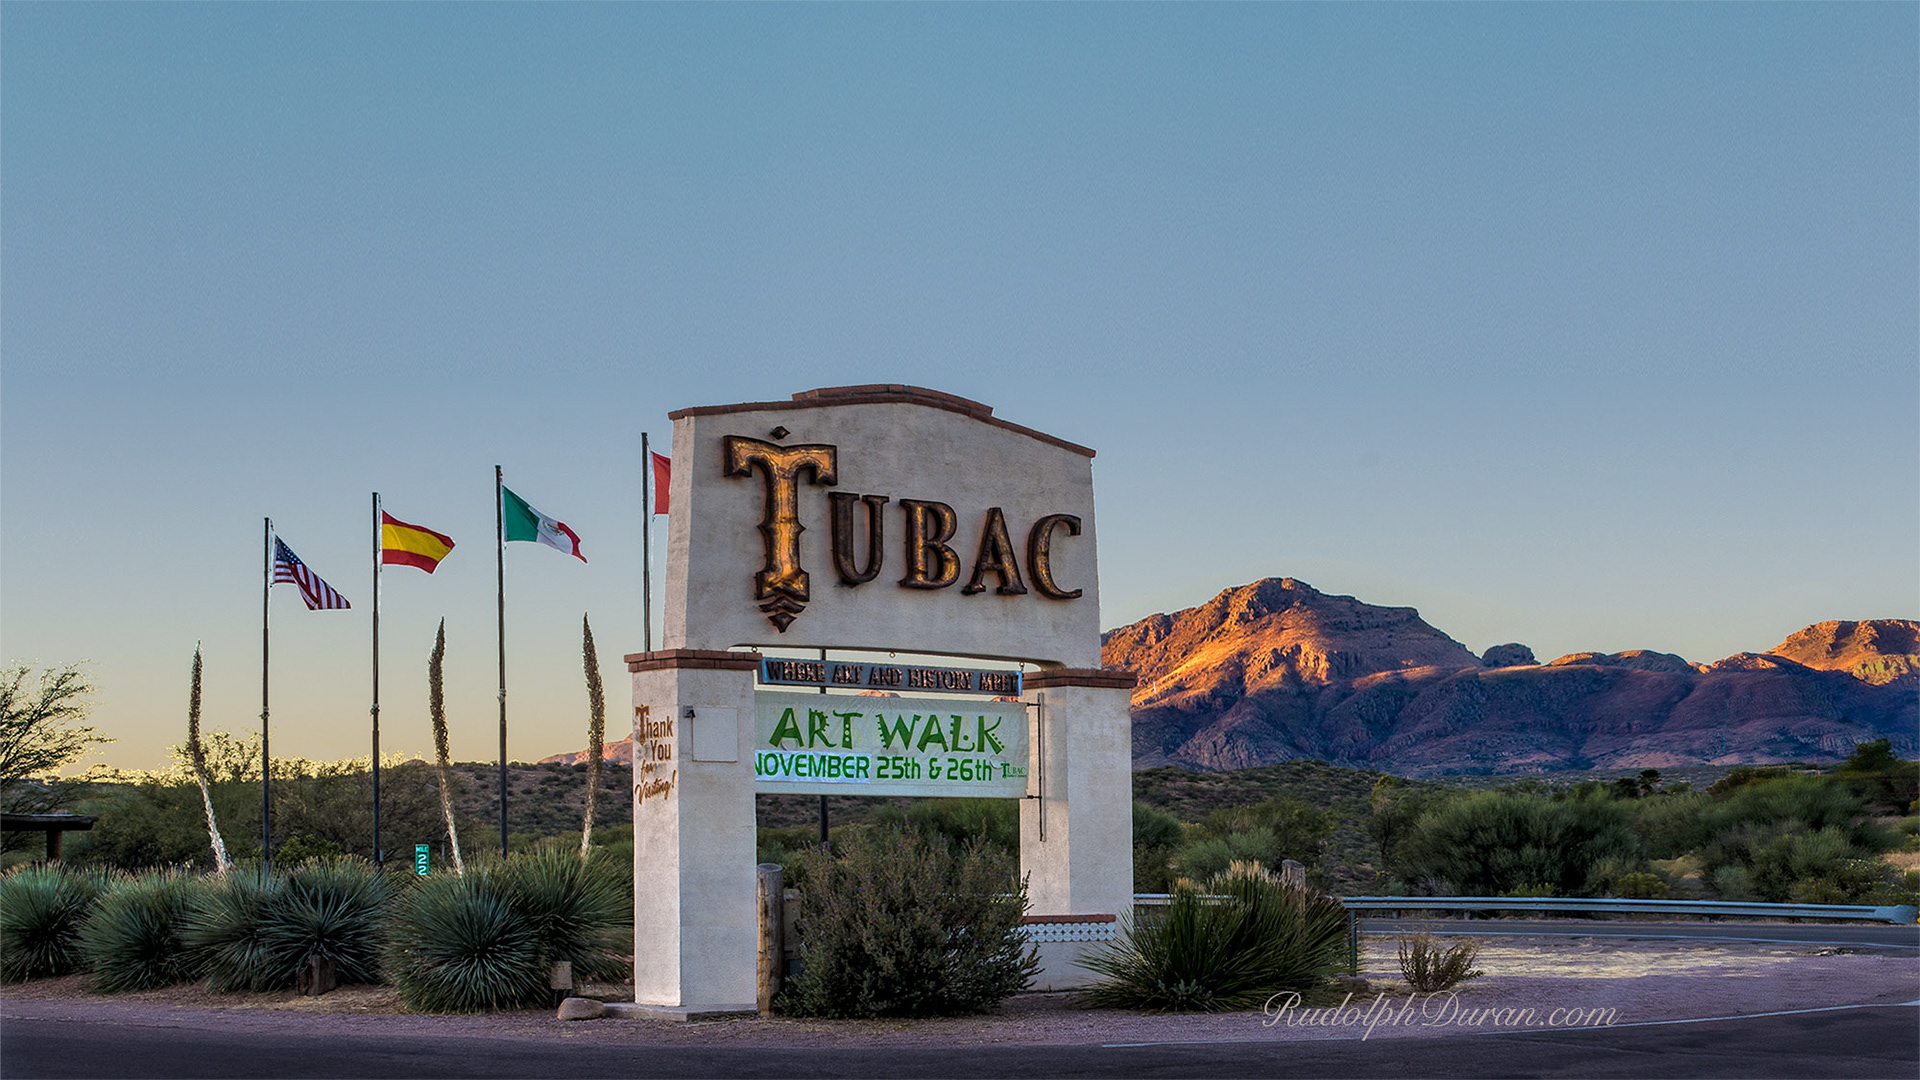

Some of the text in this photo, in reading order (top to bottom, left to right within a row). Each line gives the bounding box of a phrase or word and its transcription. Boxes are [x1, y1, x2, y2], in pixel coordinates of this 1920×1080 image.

[723, 432, 1083, 632] TUBAC
[766, 660, 1019, 693] WHERE ART AND HISTORY MEET
[635, 704, 673, 746] Thank
[769, 707, 1005, 754] ART WALK
[650, 740, 671, 761] You
[641, 760, 655, 783] for
[876, 755, 921, 780] 25th
[928, 757, 942, 780] &
[946, 757, 992, 782] 26th
[635, 770, 676, 805] Visiting!
